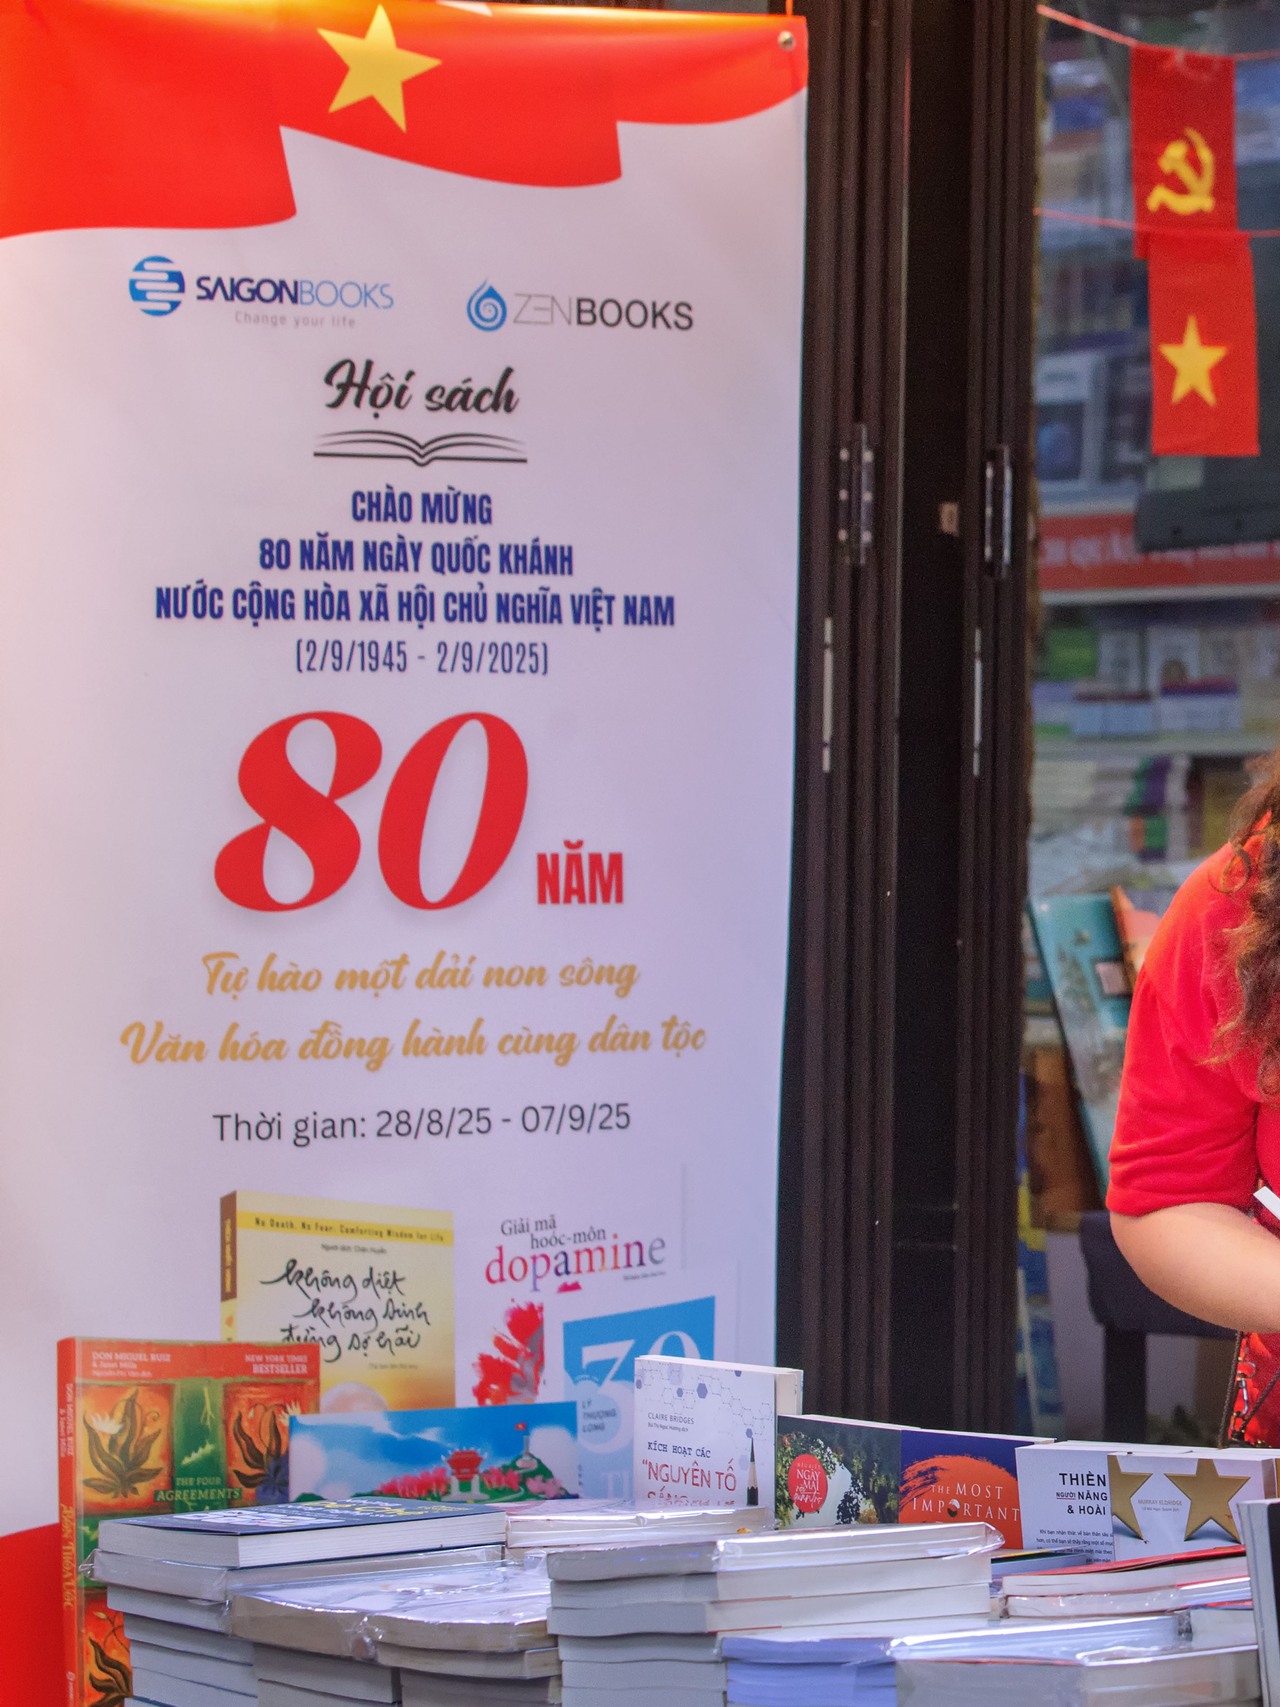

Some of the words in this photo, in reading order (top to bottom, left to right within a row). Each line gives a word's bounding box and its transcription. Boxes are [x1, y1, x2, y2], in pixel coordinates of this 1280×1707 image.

[196, 276, 394, 310] SAIGONBOOKS
[235, 311, 287, 327] Change
[294, 314, 325, 330] your
[332, 314, 355, 329] life
[514, 294, 694, 331] ZENBOOKS
[324, 358, 412, 419] Hội
[425, 366, 519, 414] sách
[352, 485, 413, 524] CHÀO
[421, 485, 493, 524] MỪNG
[259, 538, 290, 570] 80
[300, 532, 354, 572] NĂM
[363, 536, 421, 574] NGÀY
[431, 537, 490, 578] QUỐC
[500, 537, 573, 576] KHÁNH
[156, 580, 224, 620] NƯỚC
[233, 584, 296, 627] CỘNG
[304, 582, 351, 622] HÒA
[360, 585, 389, 622] XÃ
[398, 584, 435, 630] HỘI
[444, 582, 487, 624] CHỦ
[496, 586, 562, 625] NGHĨA
[571, 588, 615, 632] VIỆT
[624, 596, 675, 627] NAM
[295, 640, 407, 674] (2/9/1945
[437, 641, 549, 676] 2/9/2025)
[214, 711, 529, 912] 80
[536, 840, 624, 905] NĂM
[202, 951, 248, 1000] Tự
[256, 952, 322, 992] hào
[334, 953, 410, 999] một
[416, 950, 475, 990] dải
[482, 963, 547, 989] non
[558, 957, 640, 999] sông
[121, 1021, 206, 1065] Văn
[219, 1022, 289, 1062] hóa
[298, 1019, 391, 1072] đồng
[402, 1016, 489, 1058] hành
[497, 1020, 580, 1067] cùng
[588, 1014, 652, 1054] dân
[662, 1015, 707, 1059] tộc
[213, 1111, 282, 1142] Thời
[293, 1114, 366, 1147] gian:
[375, 1106, 492, 1139] 28/8/25
[521, 1103, 632, 1136] 07/9/25
[500, 1217, 530, 1236] Giải
[535, 1214, 557, 1231] mã
[530, 1226, 606, 1250] hoóc-môn
[485, 1233, 666, 1293] dopamine
[260, 1258, 358, 1304] không
[362, 1265, 406, 1300] diệt
[293, 1298, 378, 1334] không
[383, 1298, 431, 1326] sinh
[348, 1333, 372, 1357] sợ
[376, 1325, 421, 1356] hãi
[253, 1363, 308, 1374] BESTSELLER
[648, 1412, 668, 1422] CLAIRE
[670, 1414, 694, 1425] BRIDGES
[648, 1438, 668, 1453] KÍCH
[672, 1445, 693, 1459] HOẠT
[696, 1446, 711, 1458] CÁC
[176, 1477, 193, 1486] THE
[196, 1477, 221, 1486] FOUR
[715, 1458, 737, 1492] TỐ
[796, 1469, 820, 1481] NGÀY
[931, 1484, 950, 1495] THE
[955, 1483, 1003, 1500] MOST
[1058, 1470, 1107, 1487] THIỀN
[157, 1488, 240, 1501] AGREEMENTS
[913, 1497, 1020, 1523] IMPORTANT
[1067, 1505, 1075, 1514] &
[1079, 1504, 1106, 1516] HOÀI
